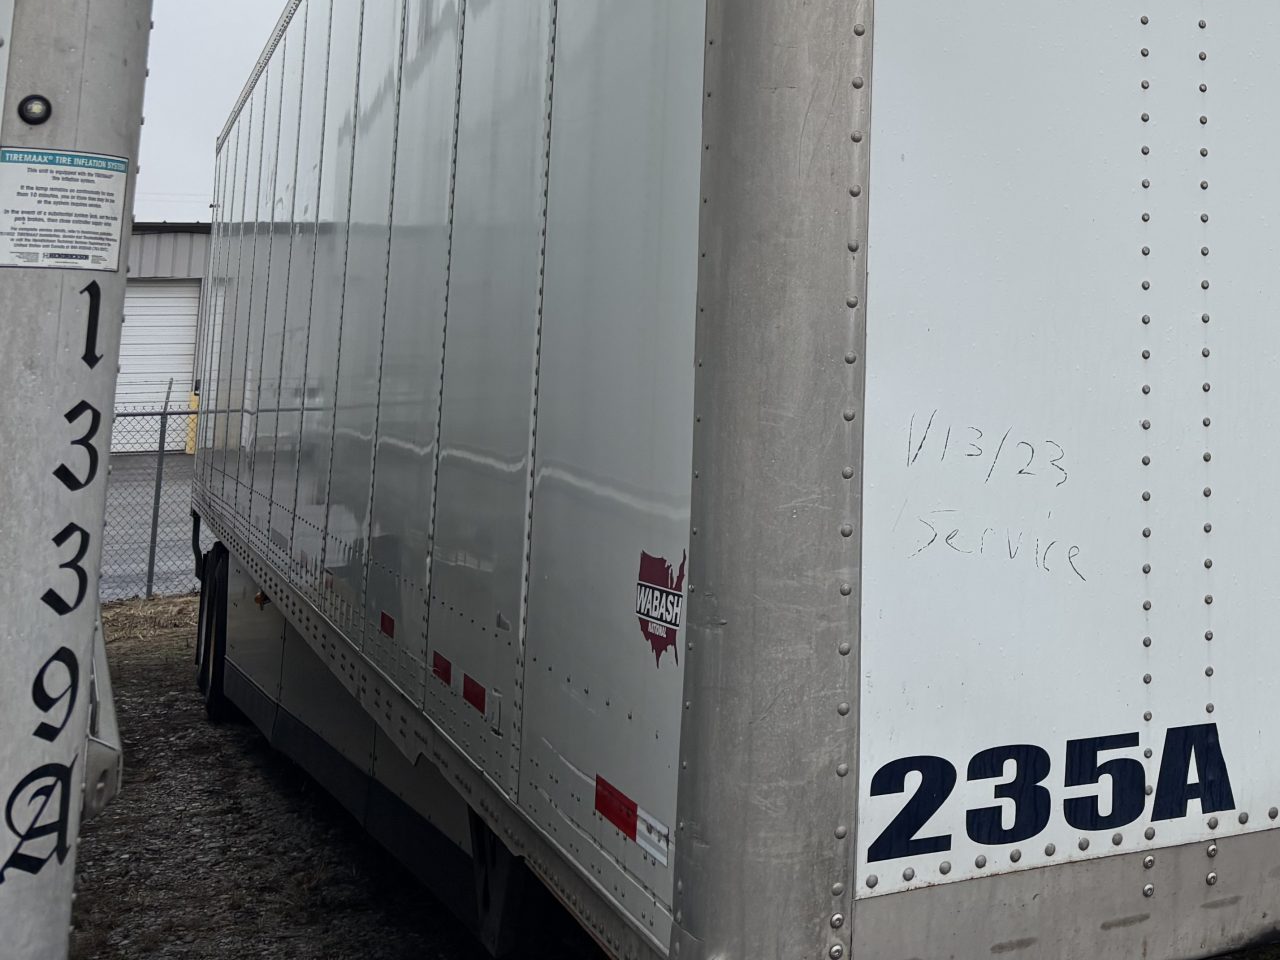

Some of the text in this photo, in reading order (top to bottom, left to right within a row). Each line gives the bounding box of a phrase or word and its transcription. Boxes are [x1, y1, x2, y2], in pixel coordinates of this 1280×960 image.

[55, 156, 72, 165] TIRE
[907, 509, 1087, 582] Service
[637, 585, 683, 625] WABASH
[647, 621, 667, 639] NATIONAL
[866, 722, 1236, 864] 235A
